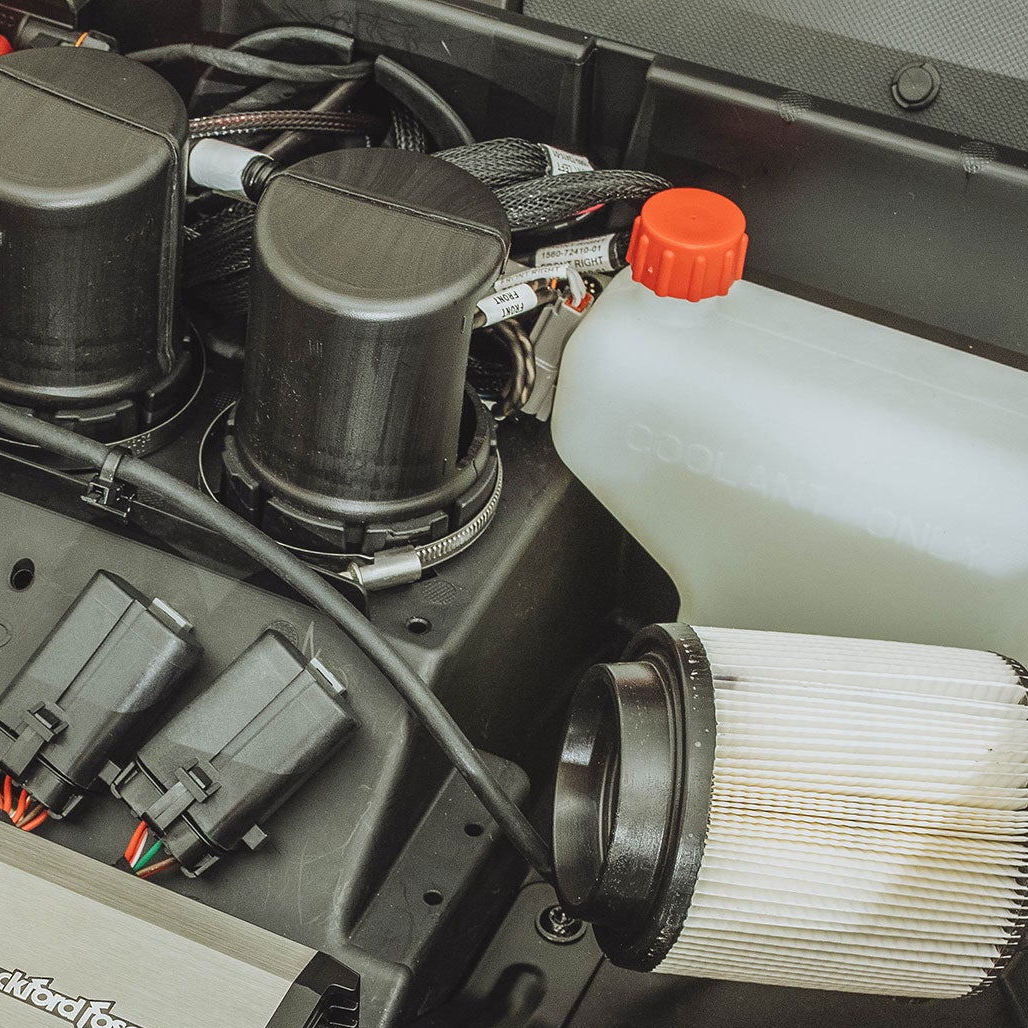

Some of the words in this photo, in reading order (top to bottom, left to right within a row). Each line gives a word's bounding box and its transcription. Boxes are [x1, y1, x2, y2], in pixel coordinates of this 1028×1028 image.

[574, 256, 603, 268] RIGHT
[493, 291, 520, 305] FRONT
[625, 422, 832, 514] COOLANT
